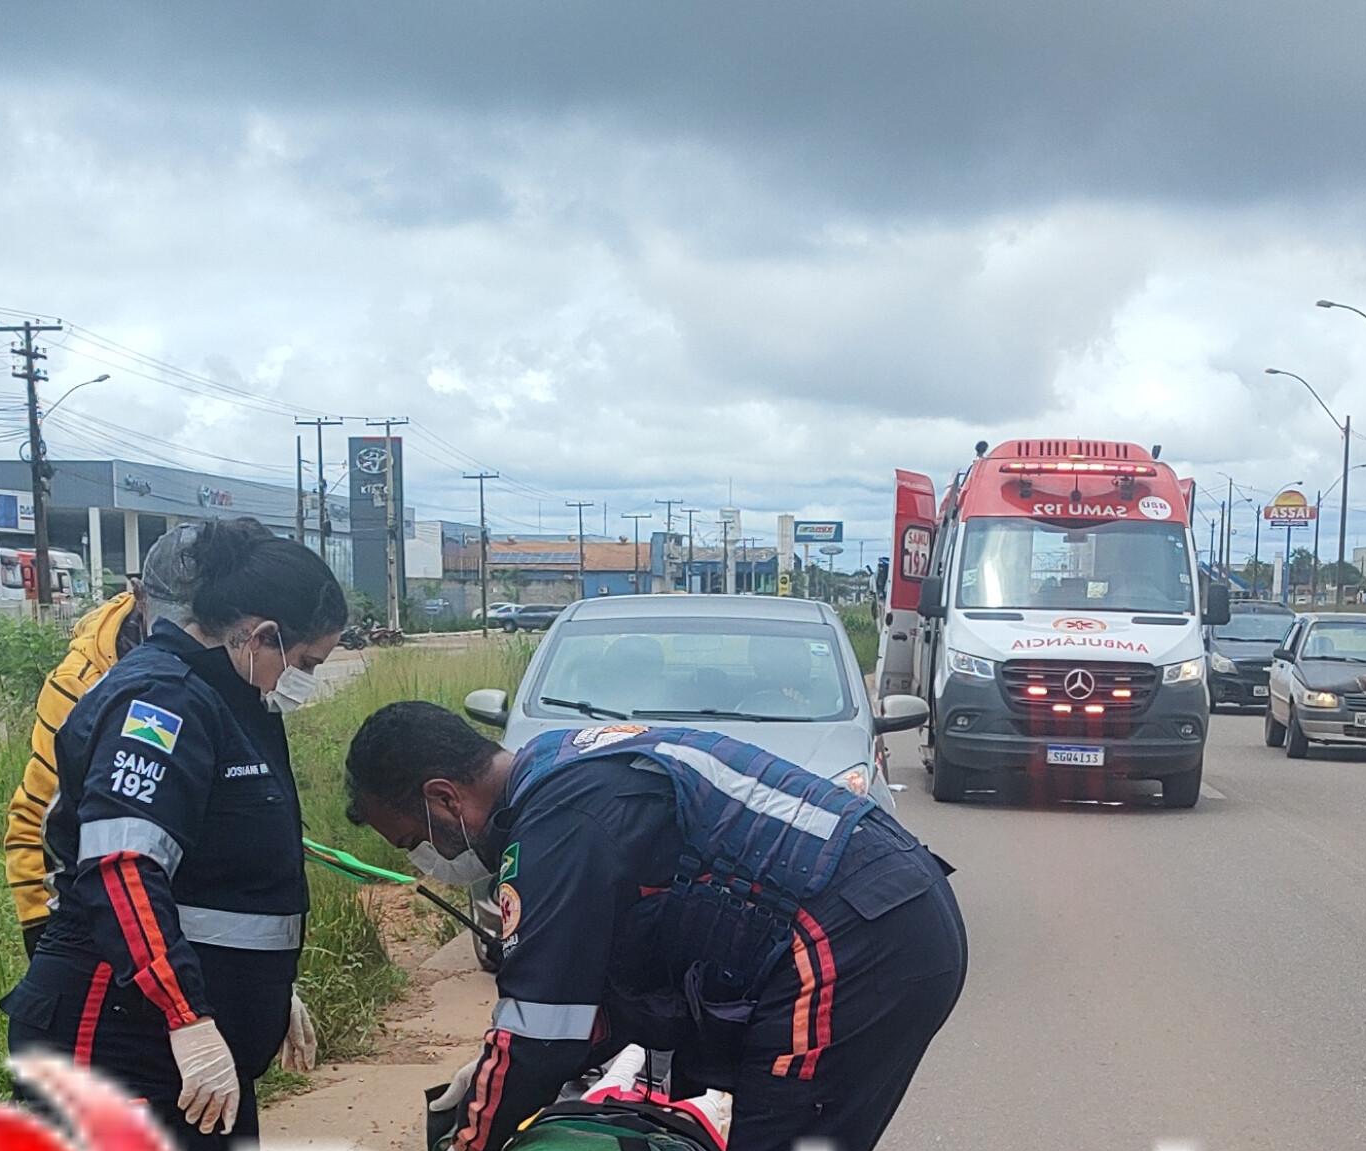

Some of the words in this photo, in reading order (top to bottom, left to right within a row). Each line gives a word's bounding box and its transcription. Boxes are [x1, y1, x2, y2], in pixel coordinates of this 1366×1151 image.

[908, 531, 929, 546] SAMU
[906, 550, 928, 577] 192
[113, 750, 167, 782] SAMU
[224, 764, 259, 778] JOSIANE
[110, 768, 157, 804] 192
